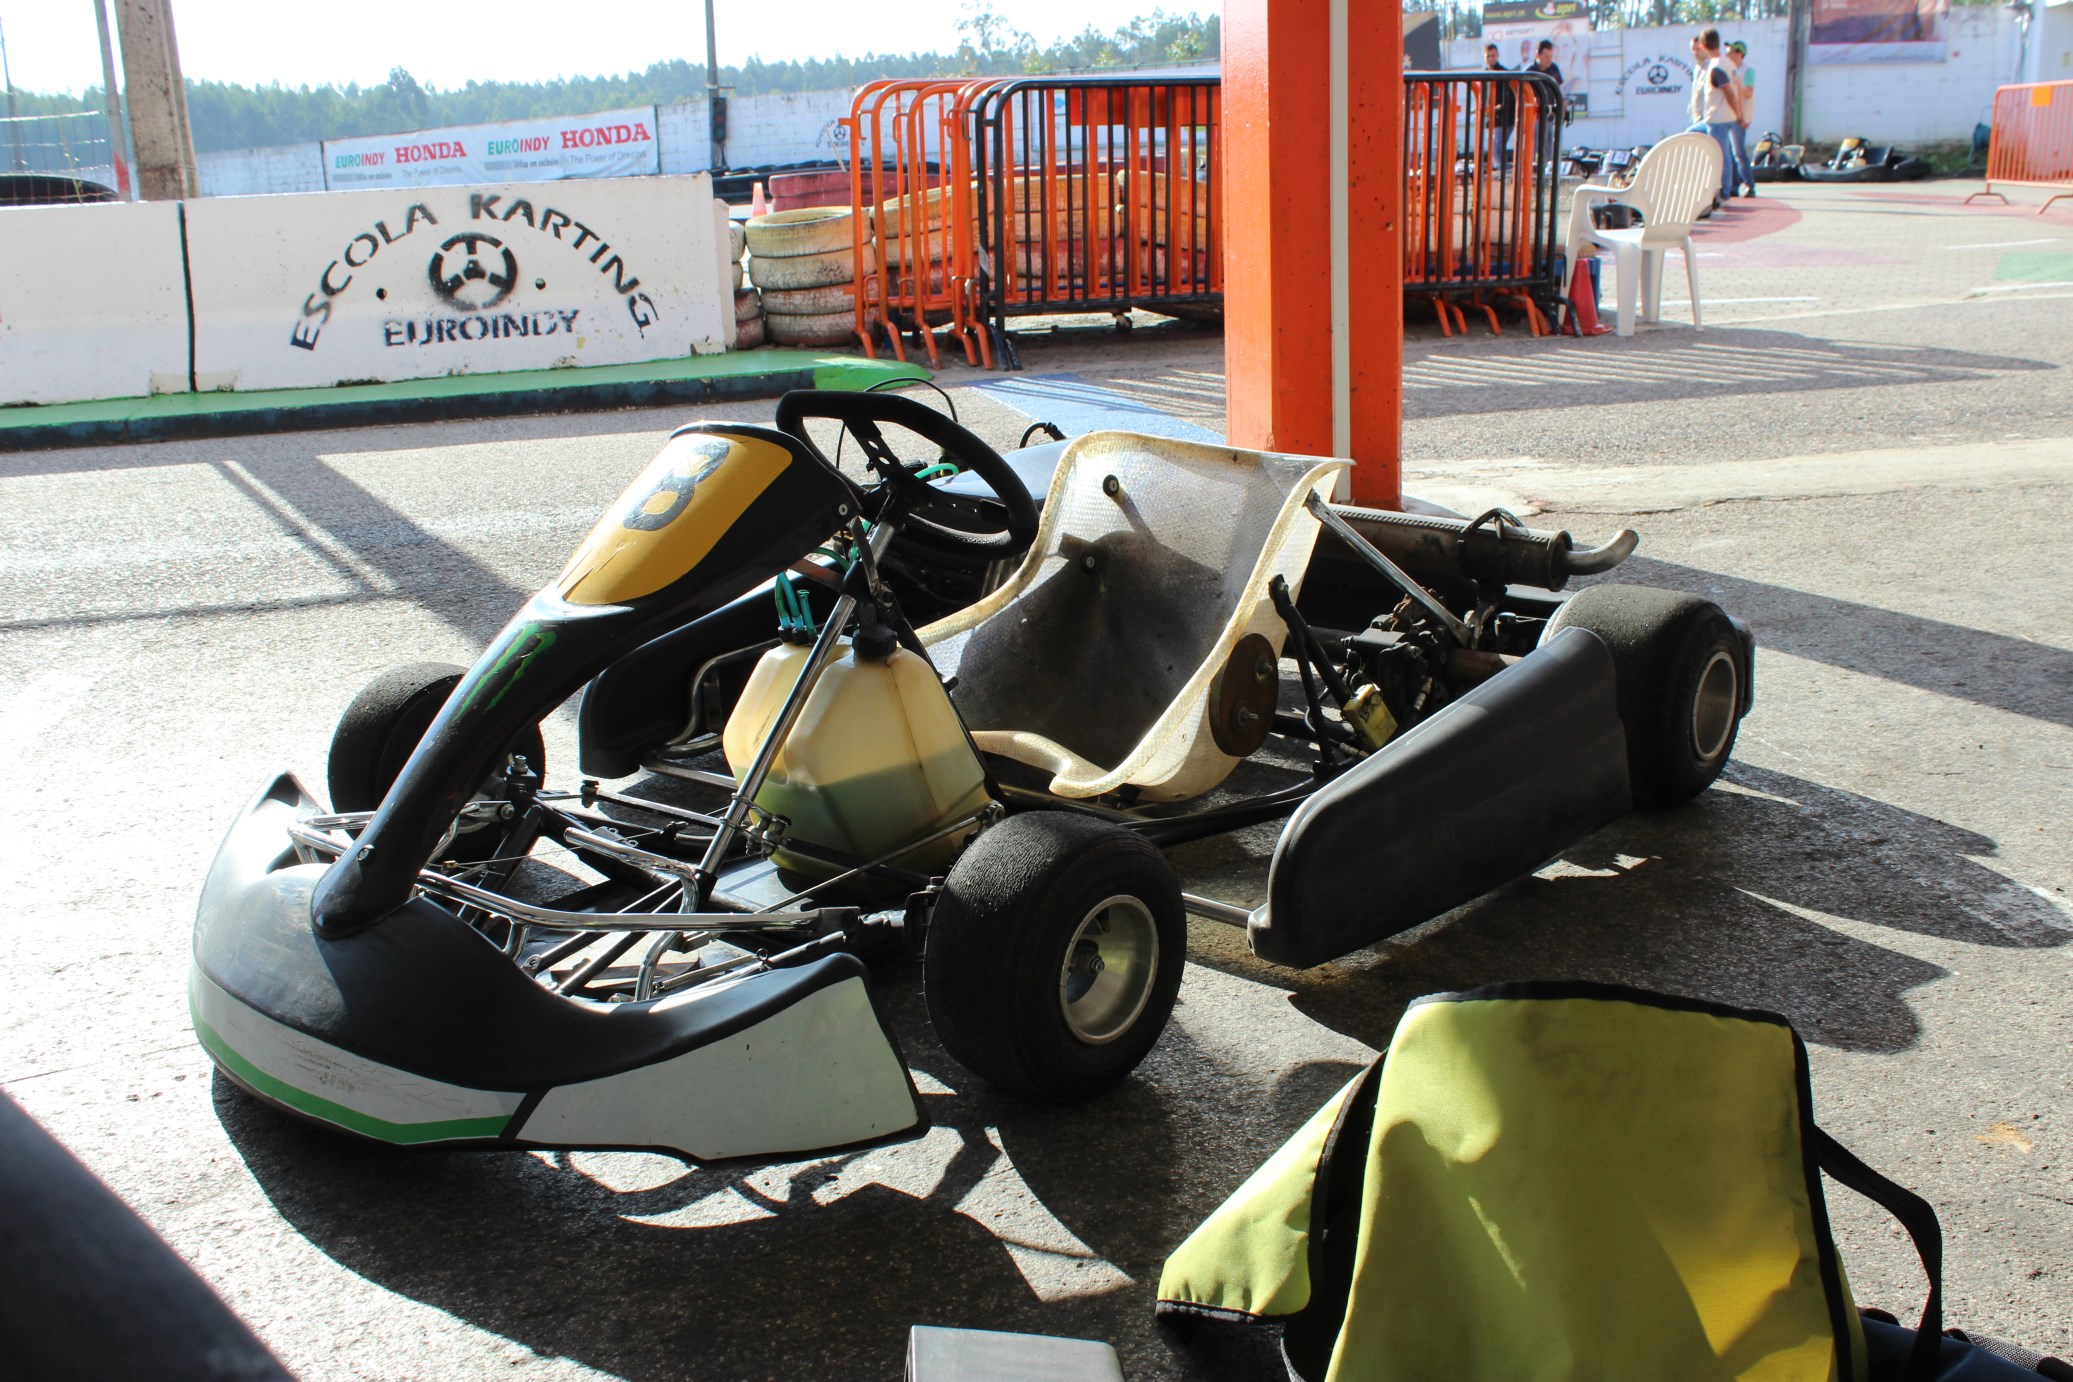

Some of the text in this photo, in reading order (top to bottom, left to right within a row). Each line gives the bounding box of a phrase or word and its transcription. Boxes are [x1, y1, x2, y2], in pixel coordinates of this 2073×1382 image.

[1505, 27, 1535, 36] ARTSOFT
[1635, 85, 1682, 95] EUROINDY
[487, 122, 651, 156] EUROINDY HONDA
[335, 141, 467, 169] EUROINDY HONDA
[570, 155, 584, 165] The
[585, 152, 607, 164] Power
[608, 151, 616, 161] of
[290, 193, 660, 351] ESCOLA KARTING
[384, 309, 580, 347] EUROINDY
[623, 439, 731, 531] 8
